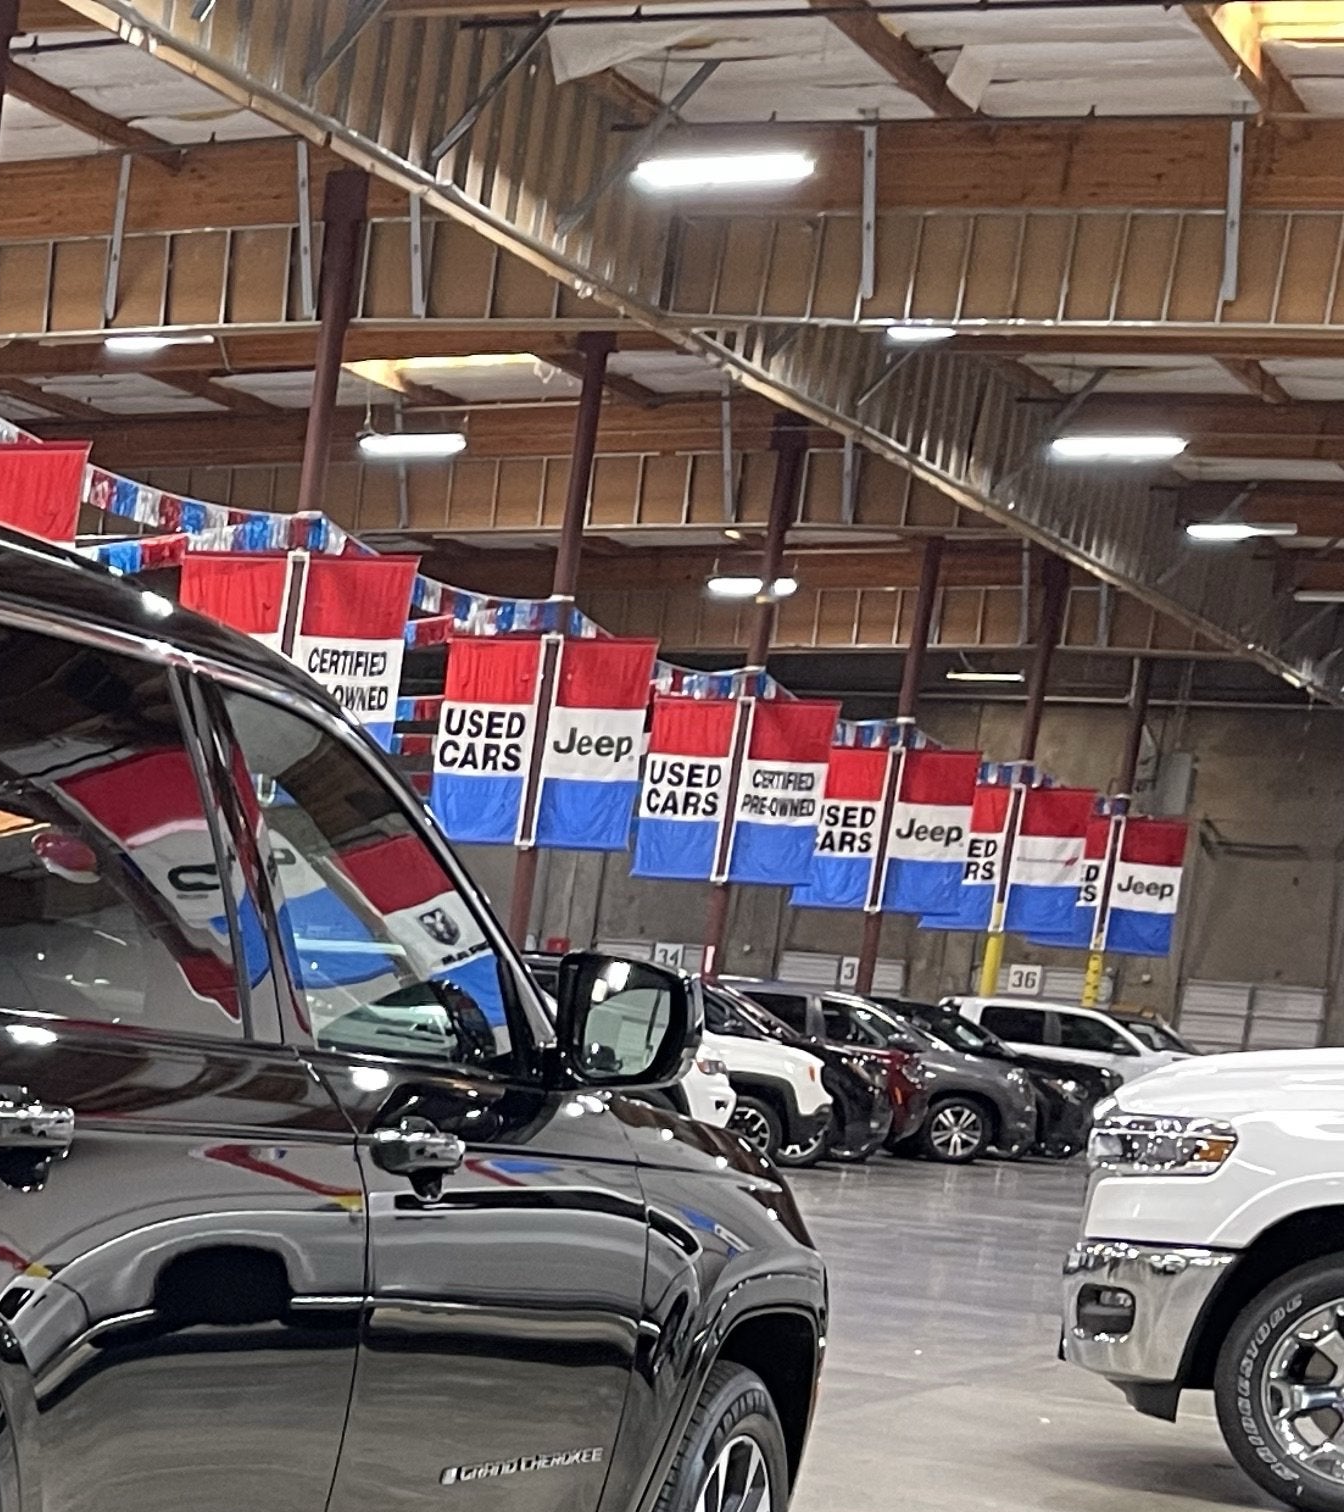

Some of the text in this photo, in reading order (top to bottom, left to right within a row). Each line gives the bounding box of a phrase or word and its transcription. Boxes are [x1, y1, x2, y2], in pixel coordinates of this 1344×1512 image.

[308, 647, 387, 677] CERTIFIED
[445, 708, 526, 739] USED
[439, 740, 522, 772] CARS
[553, 727, 633, 763] Jeep
[649, 760, 722, 789] USED
[752, 769, 815, 791] CERTIFIED
[646, 788, 719, 816] CARS
[741, 794, 815, 817] PRE-OWNED
[817, 830, 873, 852] ARS
[896, 818, 963, 847] Jeep
[967, 838, 998, 859] ED
[964, 861, 995, 881] RS
[1117, 876, 1175, 901] Jeep
[1011, 971, 1037, 989] 36
